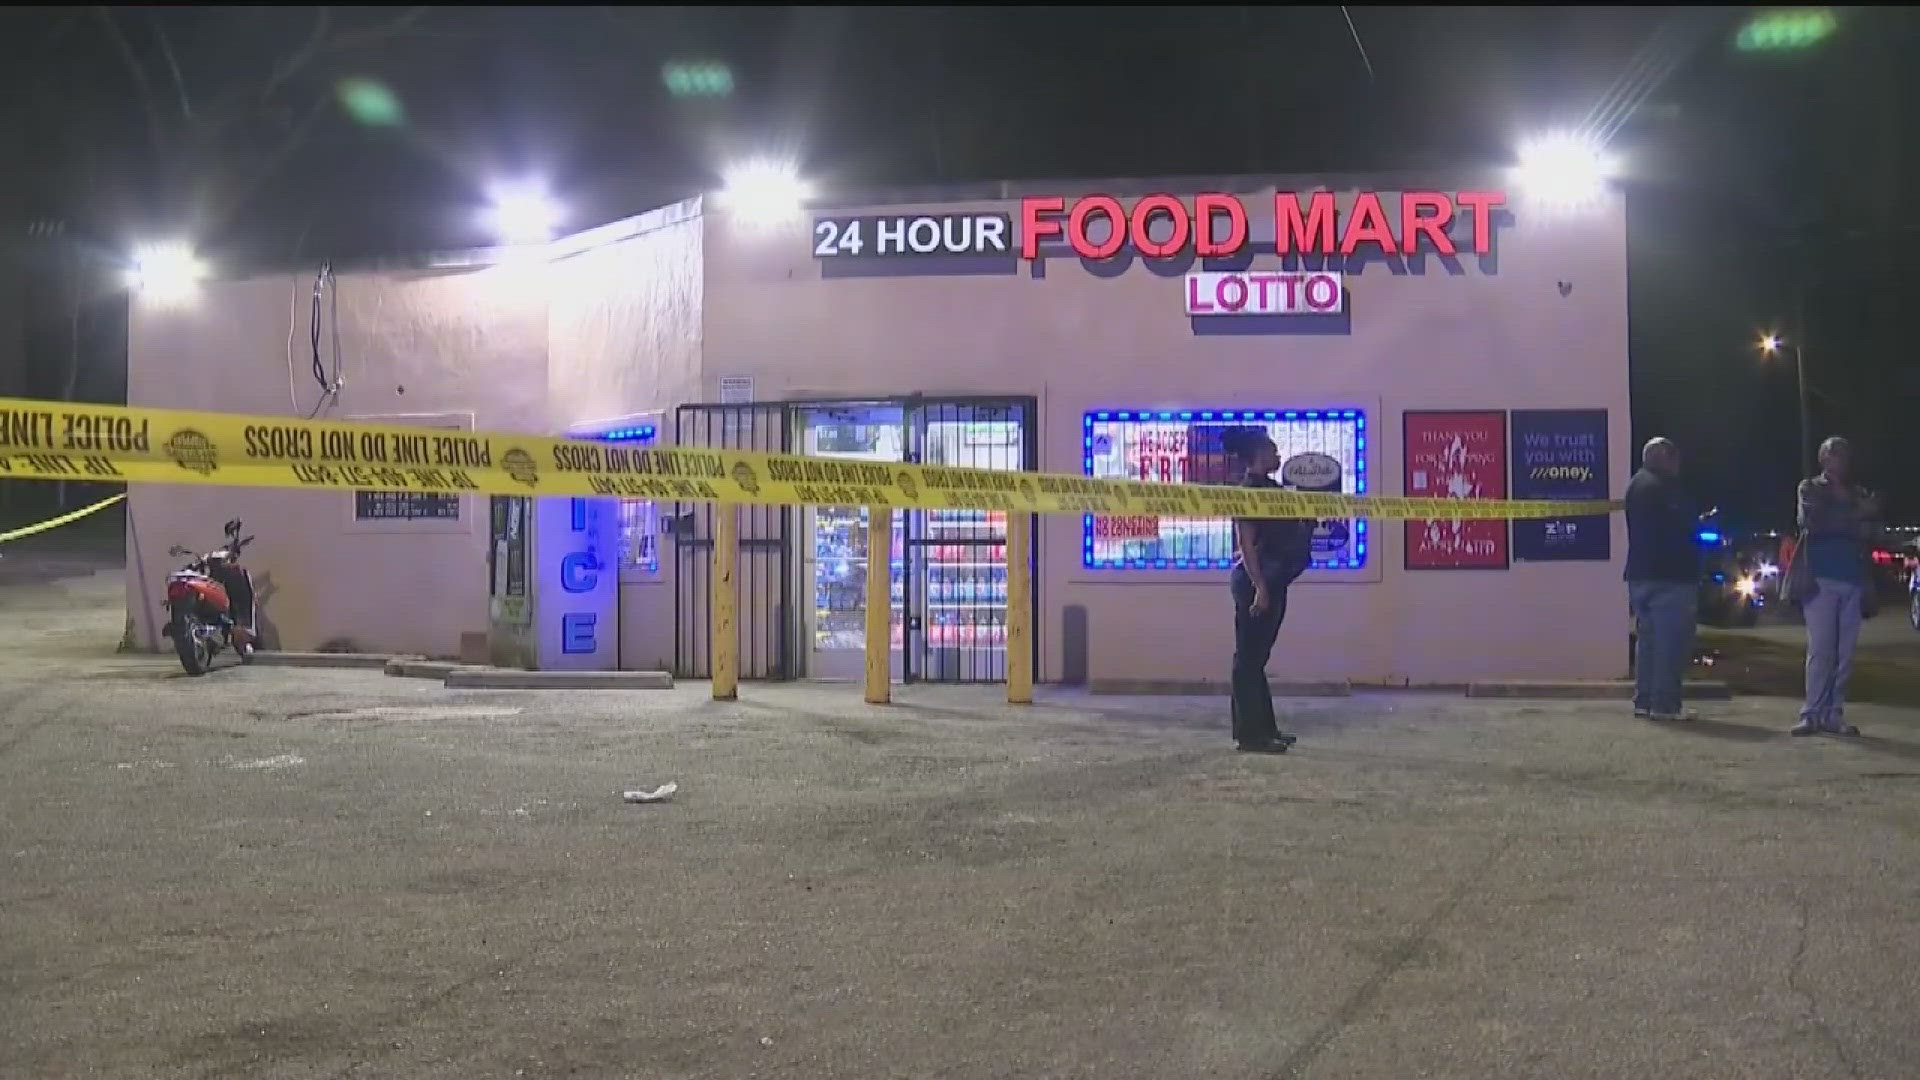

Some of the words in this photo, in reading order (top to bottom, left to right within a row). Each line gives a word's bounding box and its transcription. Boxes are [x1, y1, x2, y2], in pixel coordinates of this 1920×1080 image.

[815, 219, 863, 257] 24
[876, 216, 1006, 255] HOUR
[1021, 195, 1248, 261] FOOD
[1274, 191, 1507, 257] MART
[1189, 273, 1340, 314] LOTTO
[62, 412, 149, 453] POLICE
[244, 425, 313, 459] CROSS
[319, 429, 357, 463] NOT
[360, 431, 387, 463] DO
[1524, 433, 1549, 447] We
[1555, 433, 1594, 447] trust
[391, 434, 430, 466] LINE
[433, 437, 492, 469] POLICE
[553, 444, 601, 474] CROSS
[604, 447, 631, 474] NOT
[632, 449, 651, 475] DO
[653, 451, 681, 477] LINE
[1524, 451, 1554, 466] you
[1559, 448, 1595, 463] with
[684, 454, 726, 479] POLICE
[560, 497, 598, 654] ICE
